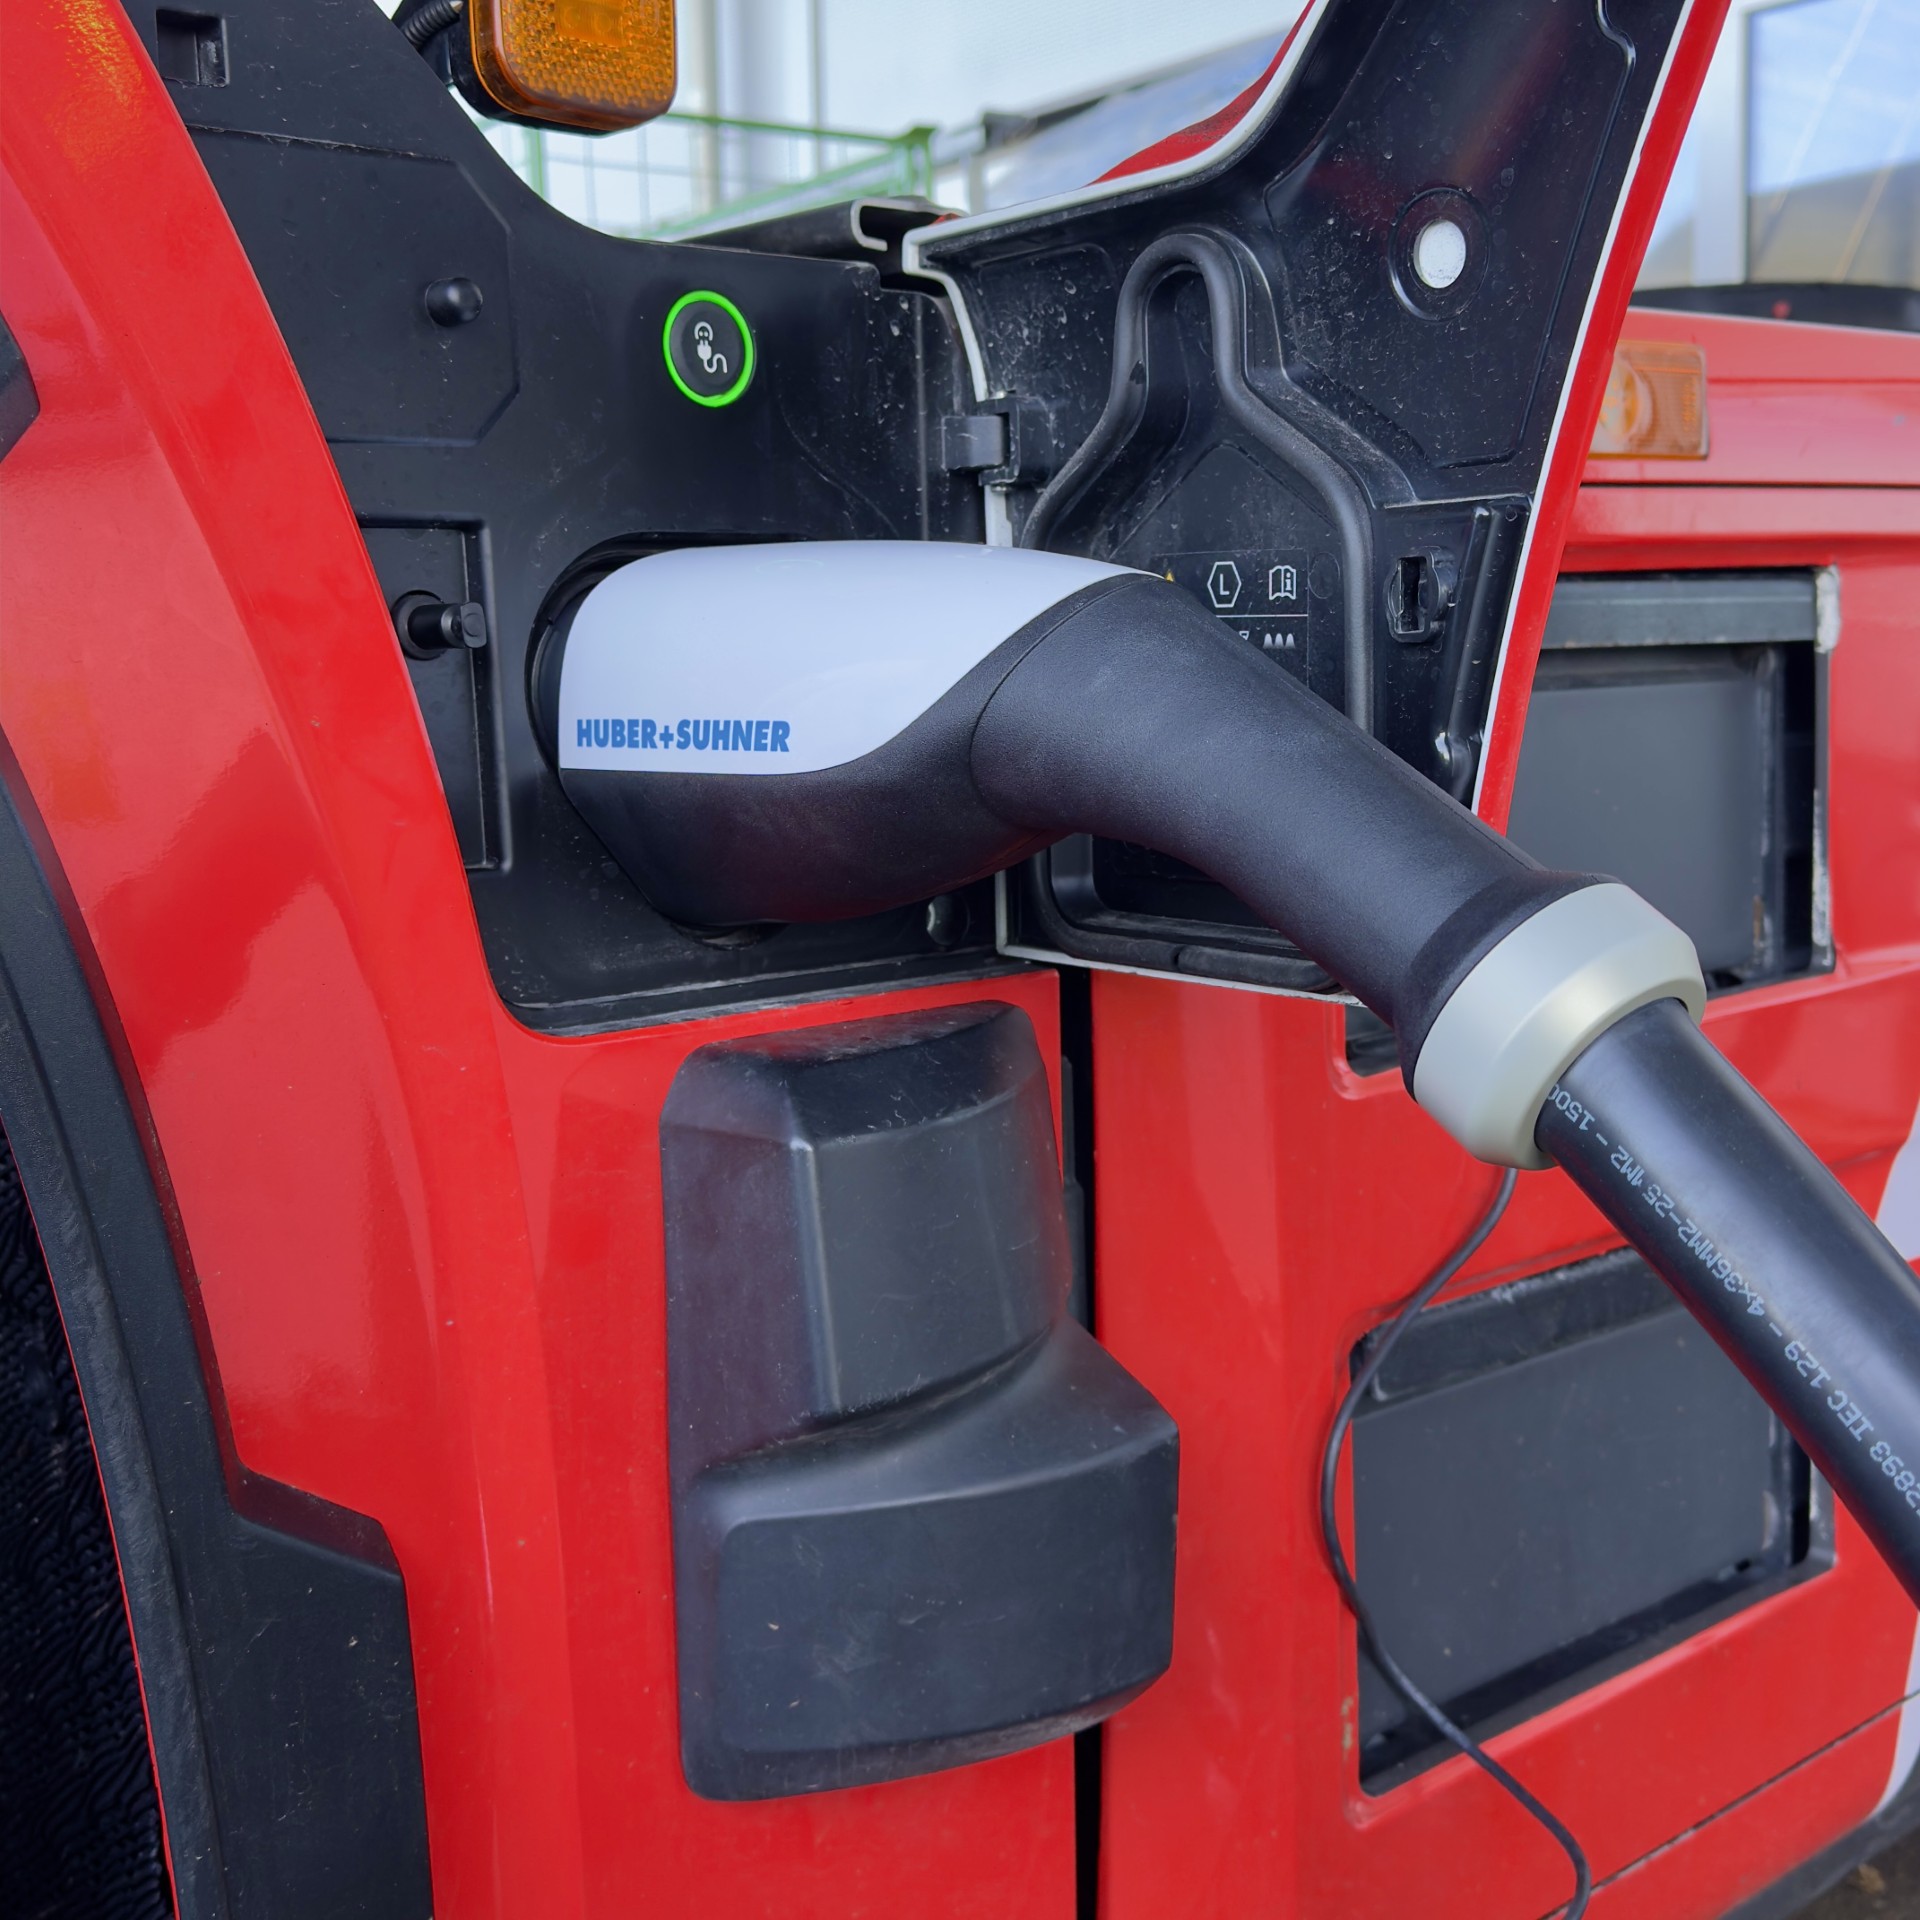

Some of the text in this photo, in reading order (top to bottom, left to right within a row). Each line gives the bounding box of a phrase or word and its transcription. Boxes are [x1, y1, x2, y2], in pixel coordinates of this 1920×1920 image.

[576, 718, 791, 752] HUBER+SUHNER
[1784, 1340, 1831, 1389] 129
[1827, 1390, 1874, 1441] IEC
[1869, 1440, 1920, 1518] 2893
